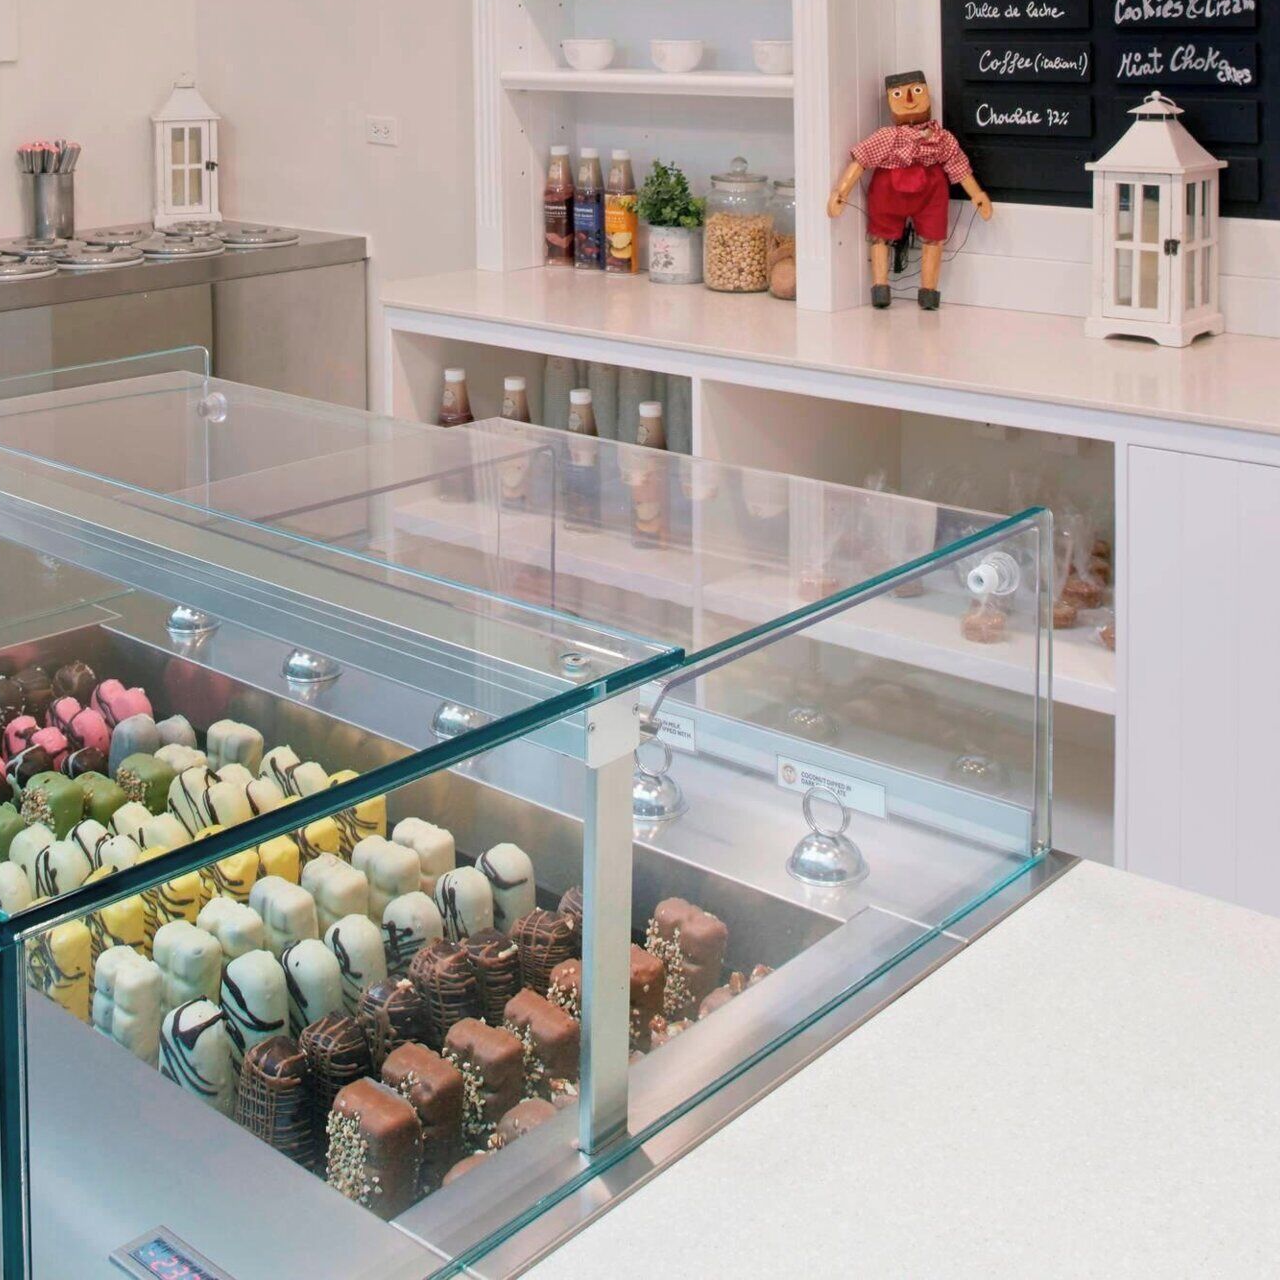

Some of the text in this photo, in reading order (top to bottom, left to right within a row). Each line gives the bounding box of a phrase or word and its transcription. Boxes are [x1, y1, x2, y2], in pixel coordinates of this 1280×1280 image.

[964, 2, 1001, 20] Dulce
[1004, 5, 1020, 18] de
[978, 49, 1033, 75] Coffee
